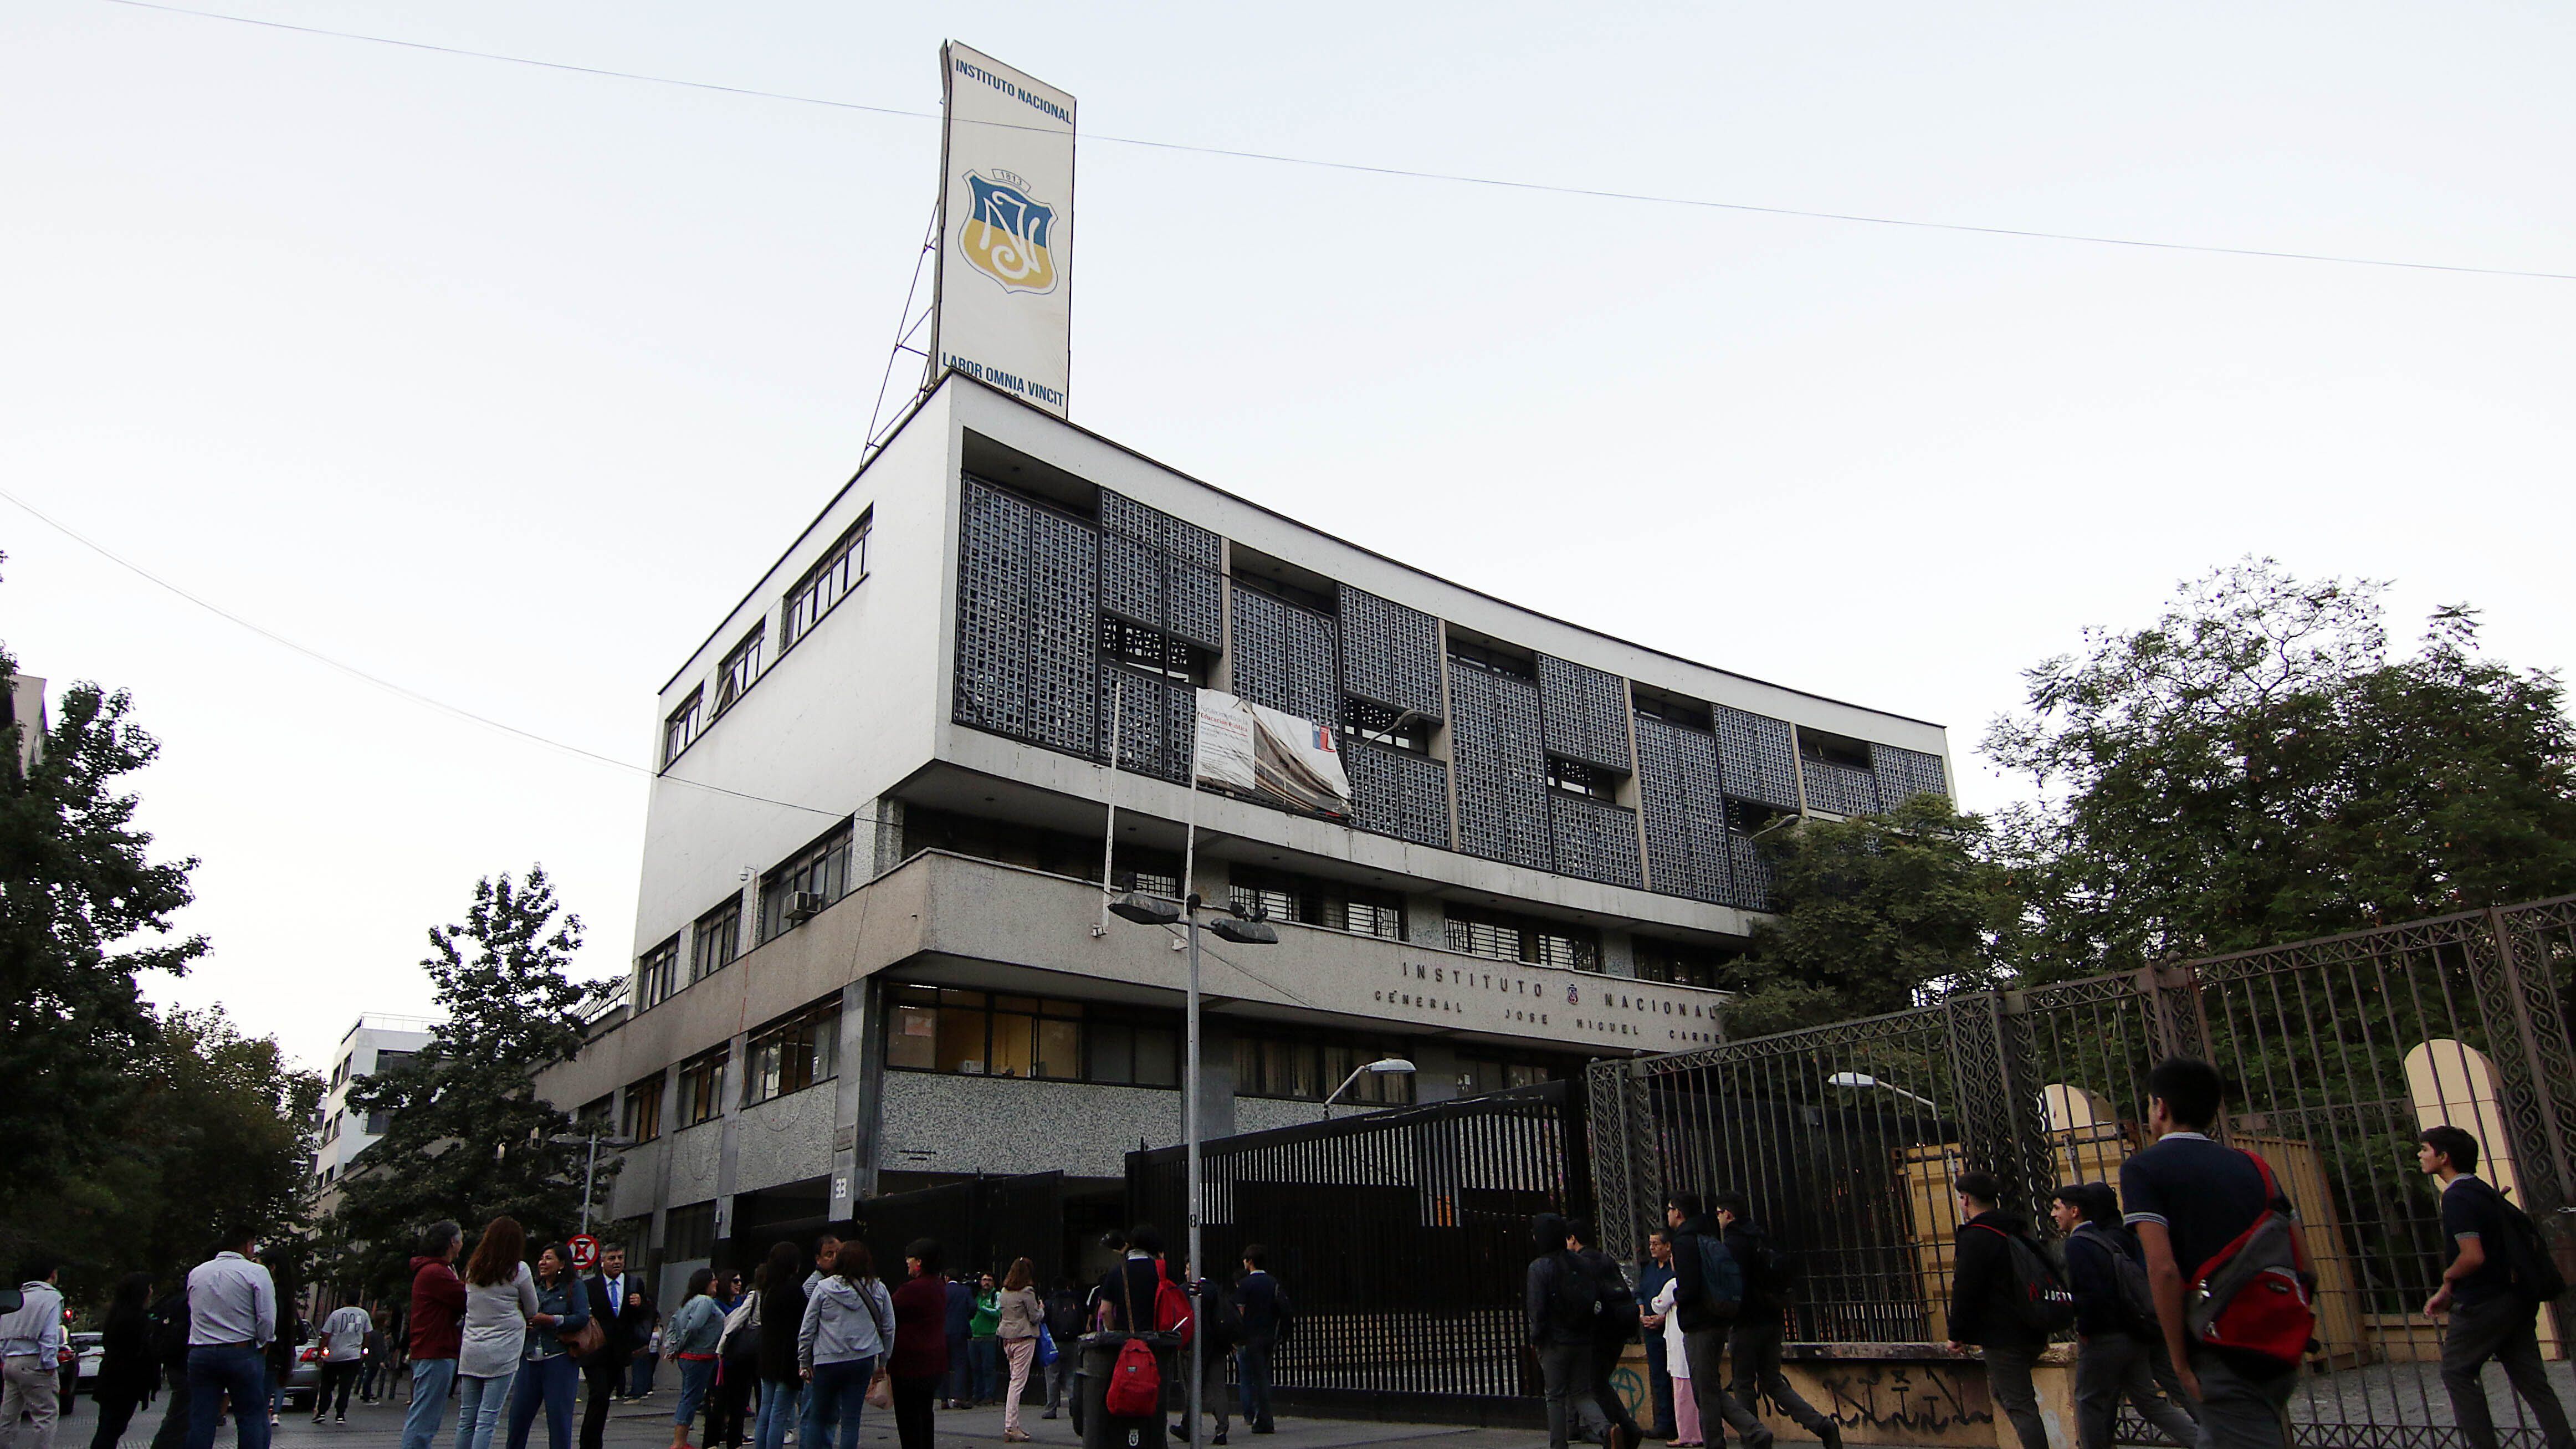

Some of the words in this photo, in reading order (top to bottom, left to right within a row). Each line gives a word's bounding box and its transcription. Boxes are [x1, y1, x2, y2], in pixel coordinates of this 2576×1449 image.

[956, 59, 1014, 96] INSTITUTO
[1018, 88, 1072, 125] NACIONAL
[1001, 171, 1022, 186] 1813
[943, 351, 982, 378] LABOR
[986, 367, 1025, 393] OMNIA
[1028, 381, 1064, 407] VINCIT
[1375, 990, 1462, 1013] GENERAL
[1505, 1009, 1548, 1025] JOSE
[1576, 1018, 1638, 1035] MIGUEL
[1669, 1030, 1720, 1044] CARRE
[1403, 961, 1541, 997] INSTITUTO
[1605, 993, 1715, 1020] NACIONAL
[836, 1178, 847, 1198] 33
[1190, 1214, 1197, 1228] 8
